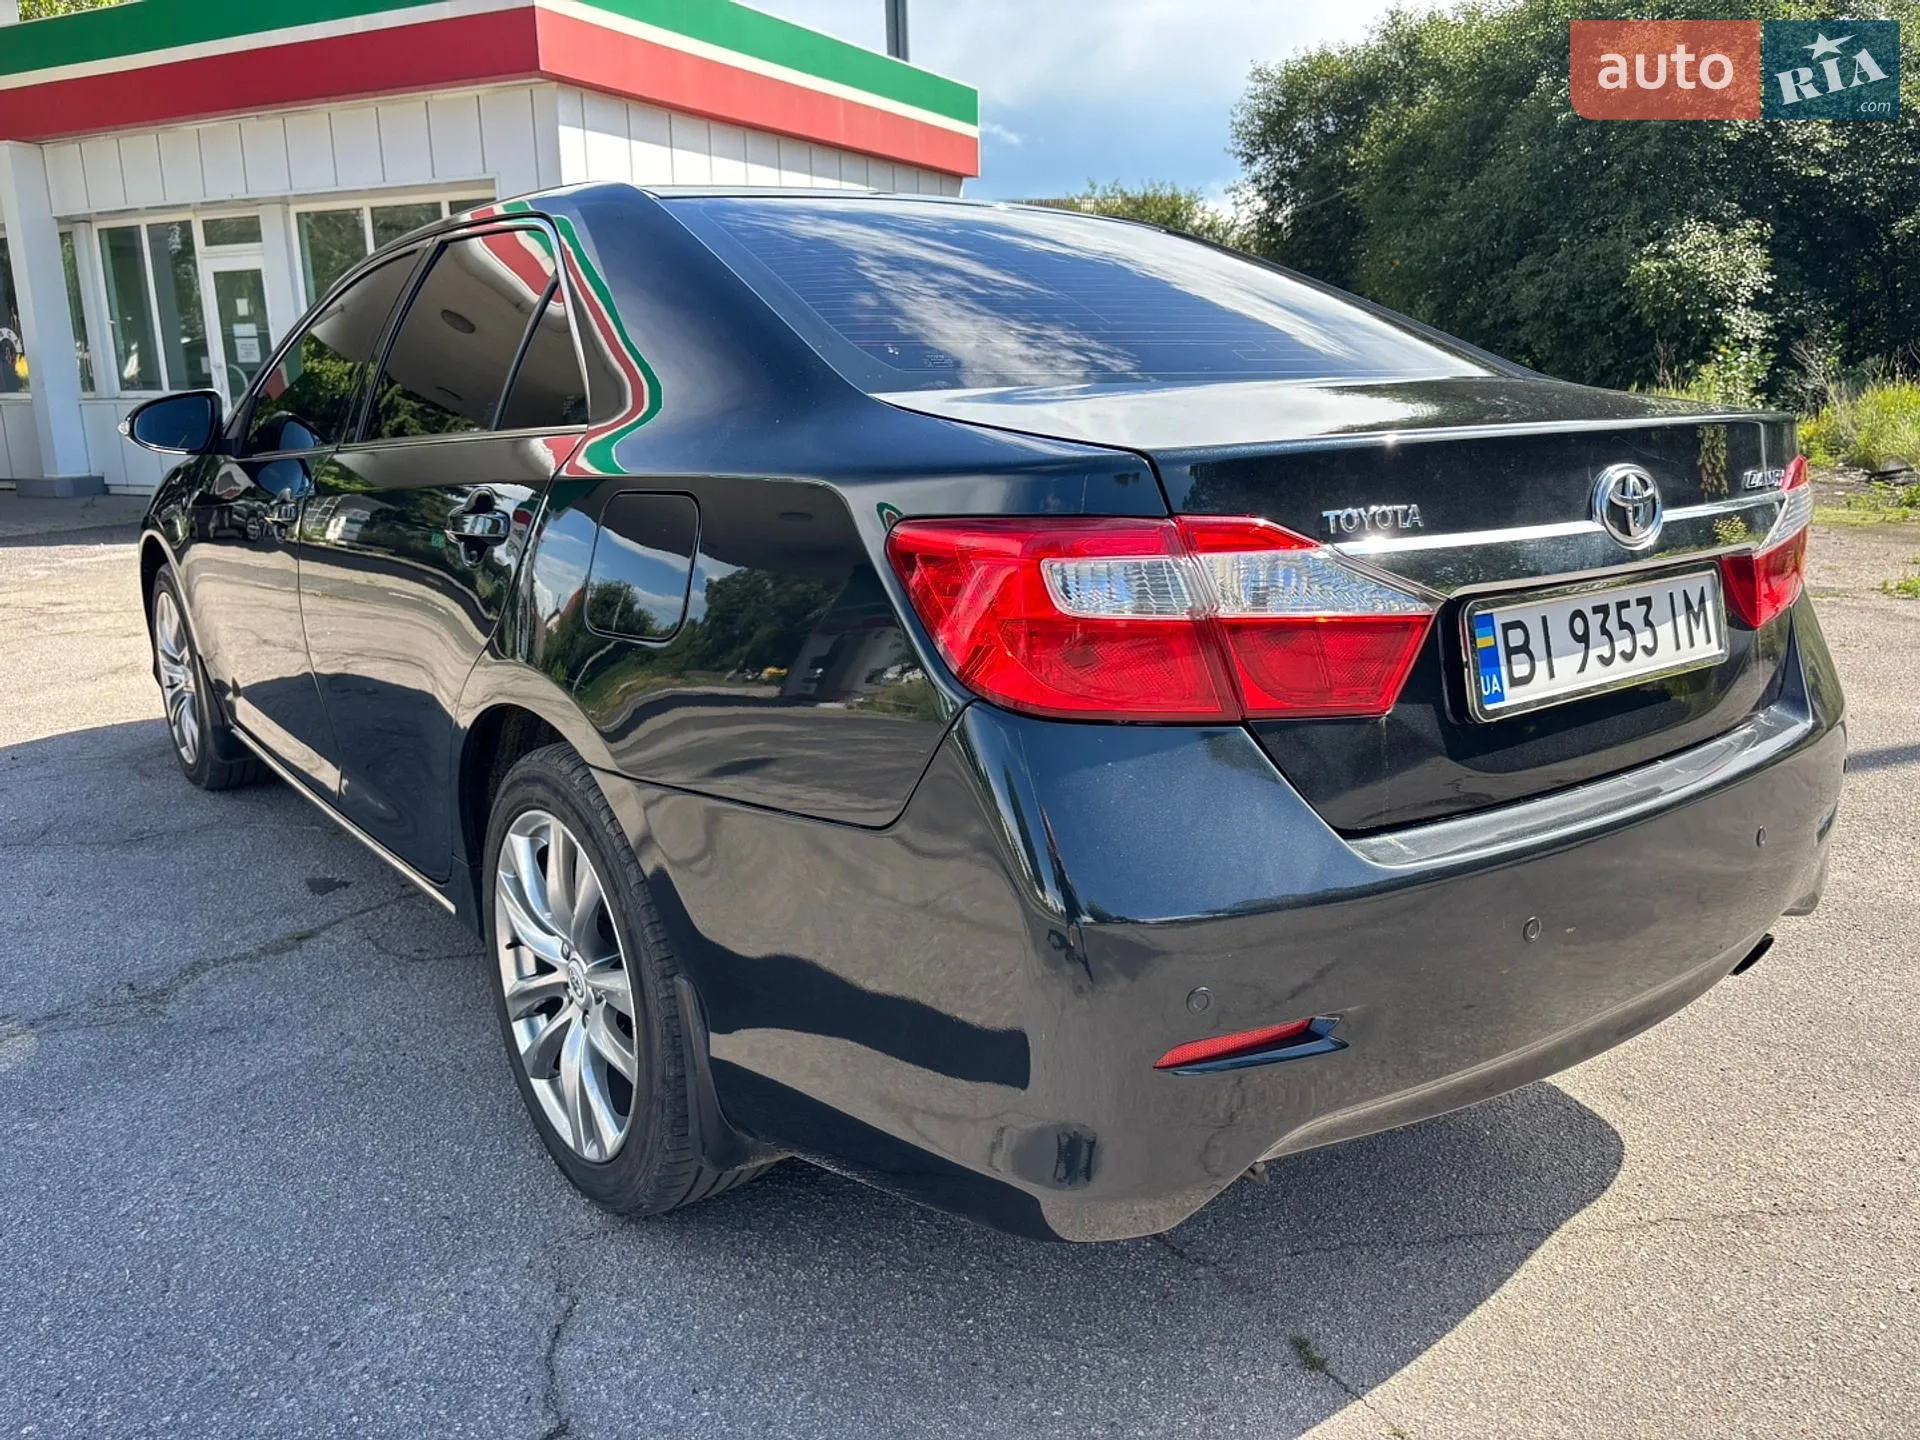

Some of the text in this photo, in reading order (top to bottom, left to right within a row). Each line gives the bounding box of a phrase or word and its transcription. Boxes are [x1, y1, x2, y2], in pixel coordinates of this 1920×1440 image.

[1322, 504, 1424, 535] TOYOTA
[1501, 585, 1711, 688] BI 9353 IM
[1480, 675, 1501, 696] UA
